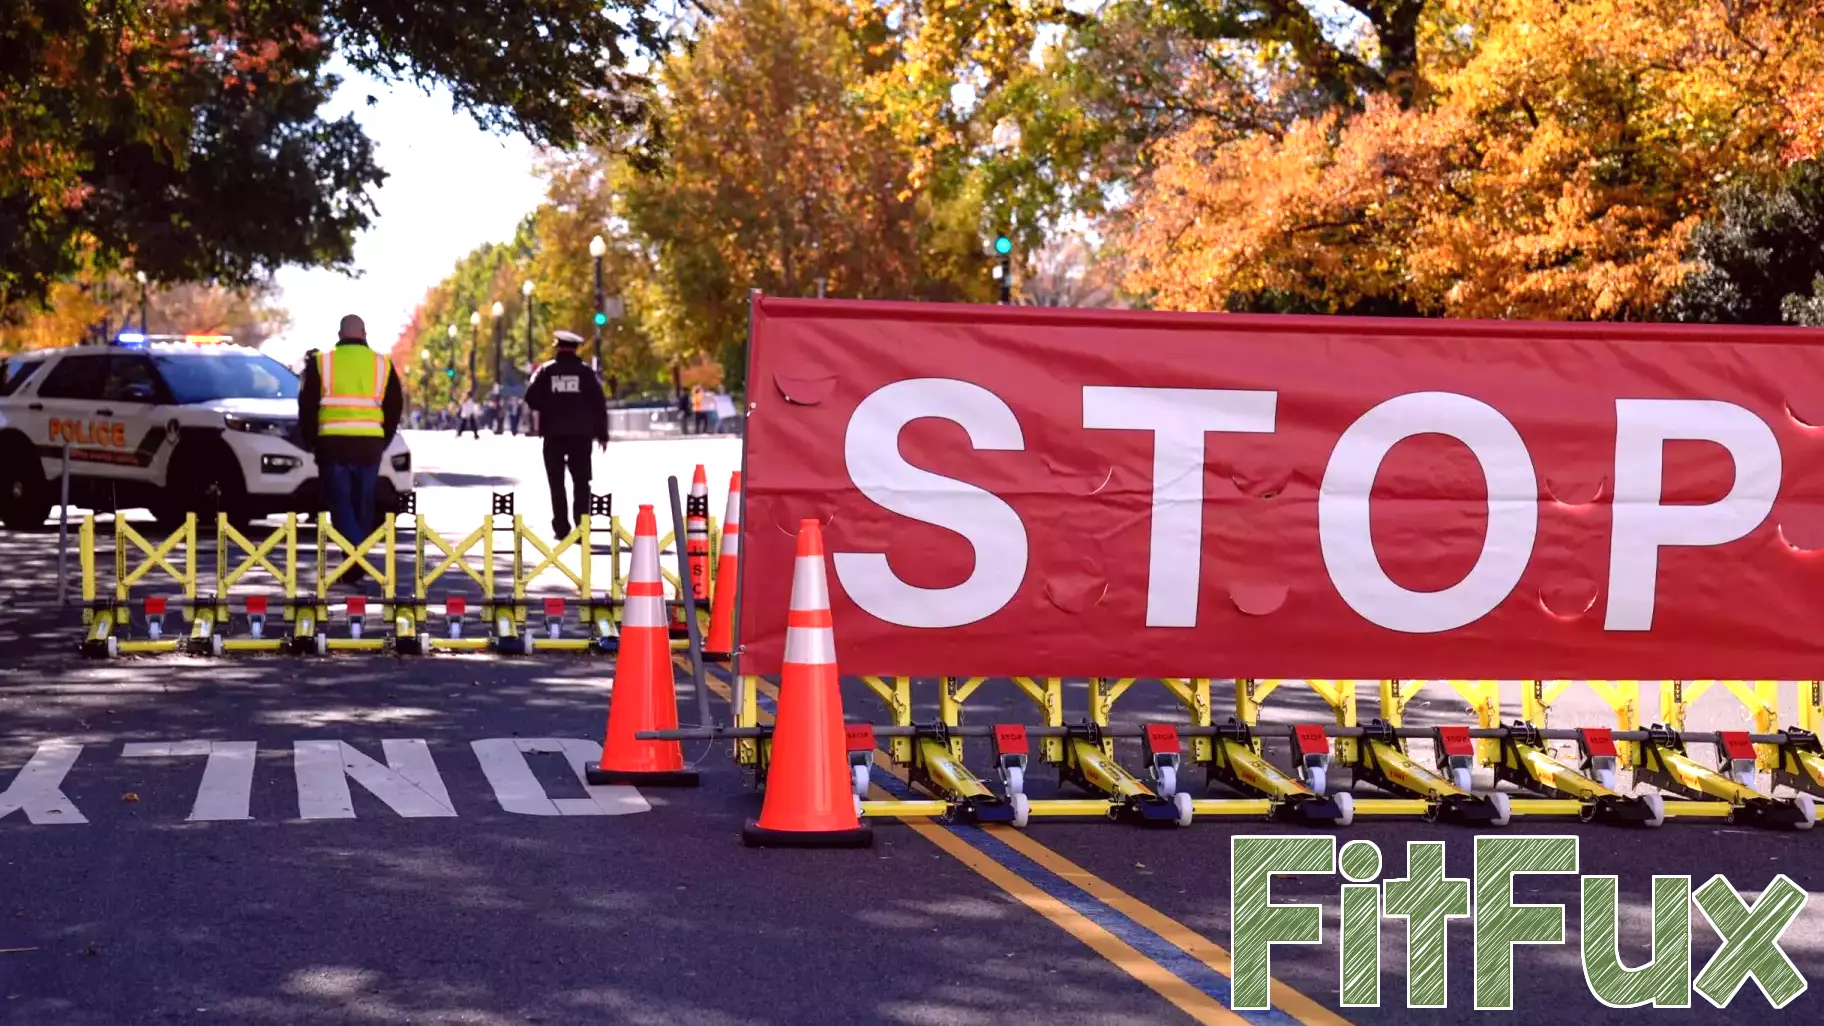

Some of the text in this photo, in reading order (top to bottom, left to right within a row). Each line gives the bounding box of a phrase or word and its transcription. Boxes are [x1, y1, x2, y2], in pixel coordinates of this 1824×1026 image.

[48, 417, 126, 448] POLICE
[833, 376, 1782, 633] STOP
[0, 737, 652, 825] ONLY
